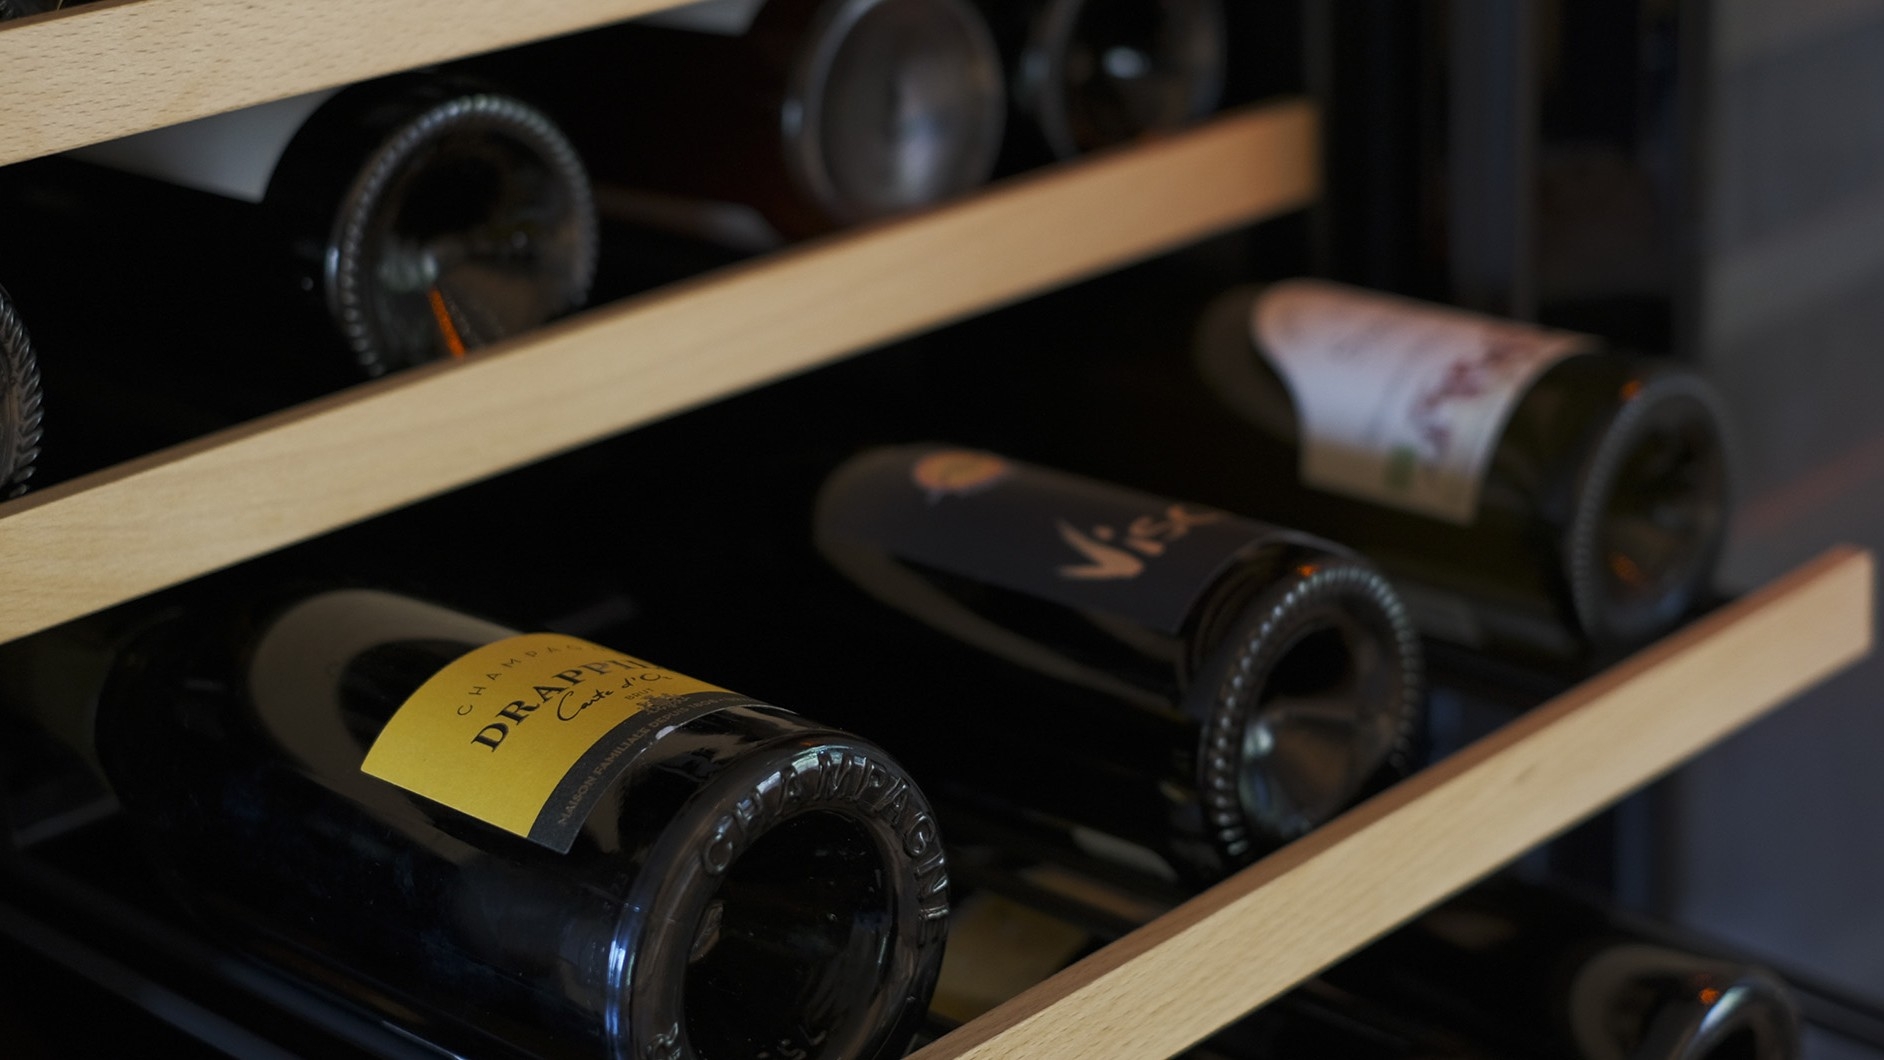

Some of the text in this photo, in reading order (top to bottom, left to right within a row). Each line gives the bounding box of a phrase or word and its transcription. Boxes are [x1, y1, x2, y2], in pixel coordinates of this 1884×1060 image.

[557, 689, 614, 721] Carte
[625, 687, 654, 700] BRUT
[558, 776, 597, 827] MAISON
[594, 728, 650, 776] FAMILIALE
[651, 705, 691, 728] DEPUIS
